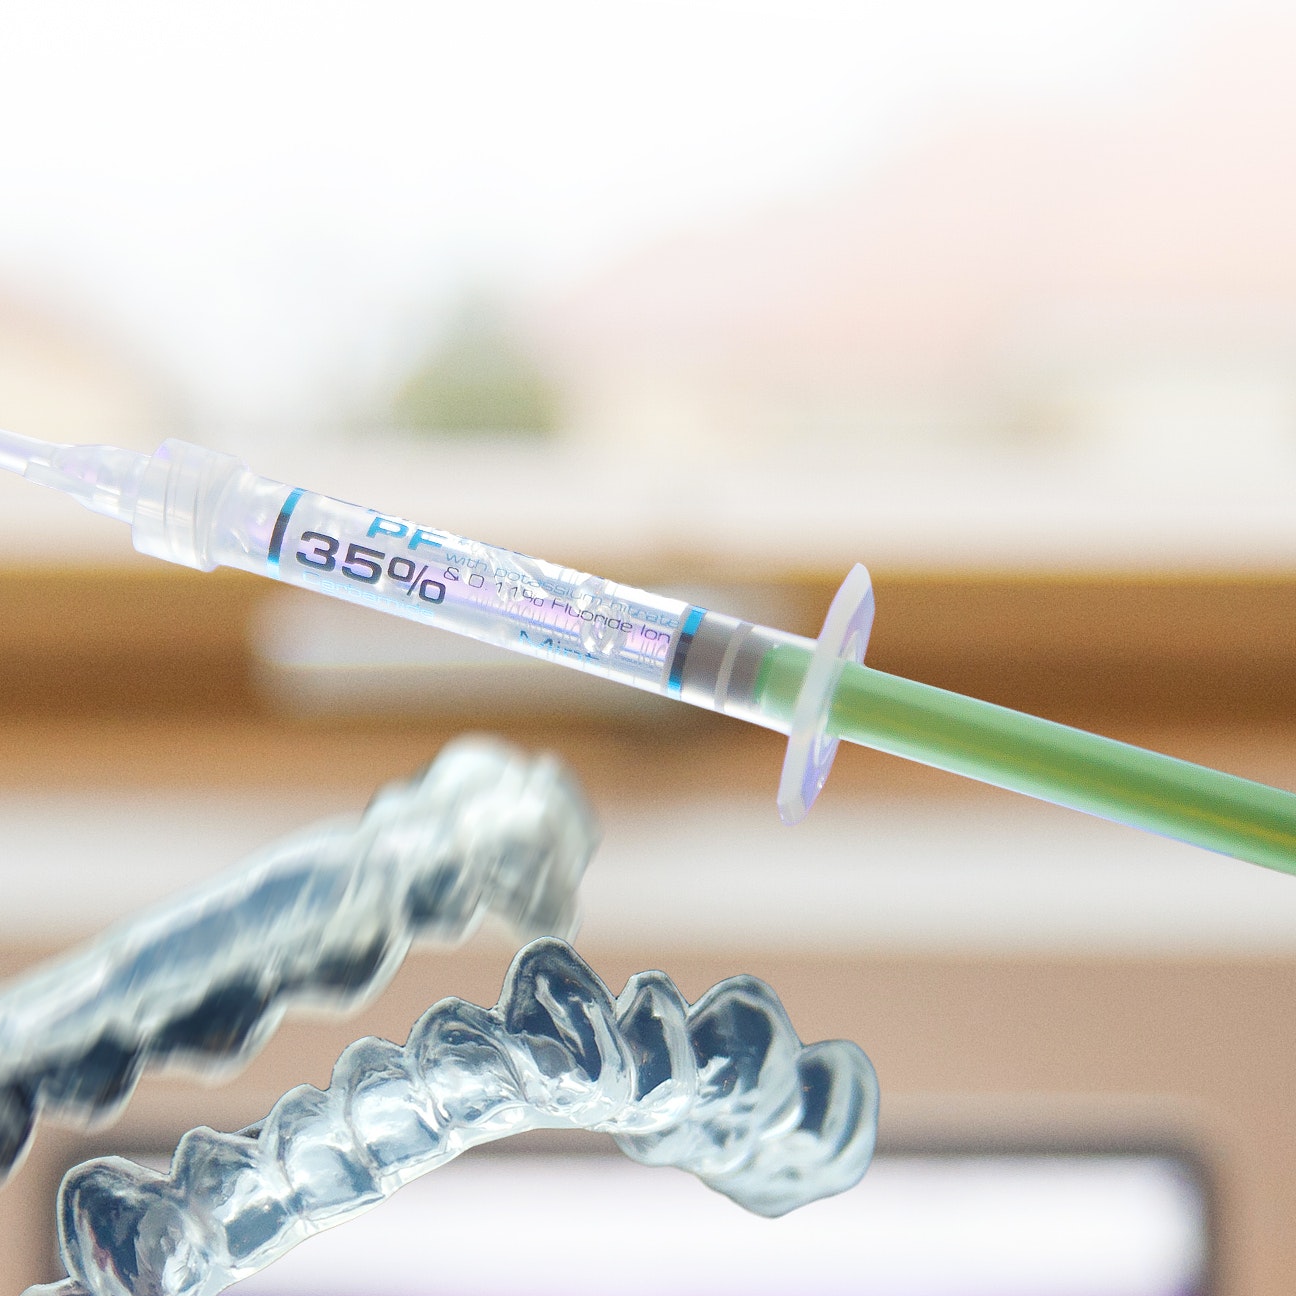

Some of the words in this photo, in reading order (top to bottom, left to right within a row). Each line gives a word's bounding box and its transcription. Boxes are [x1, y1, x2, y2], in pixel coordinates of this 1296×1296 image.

[295, 530, 447, 605] 35%
[366, 516, 448, 551] PF
[302, 571, 435, 617] Carbamide
[444, 566, 459, 581] &
[551, 597, 634, 634] Fluoride
[640, 624, 672, 644] Ion
[446, 553, 488, 572] with
[494, 567, 603, 606] potassium
[610, 600, 680, 629] nitrate
